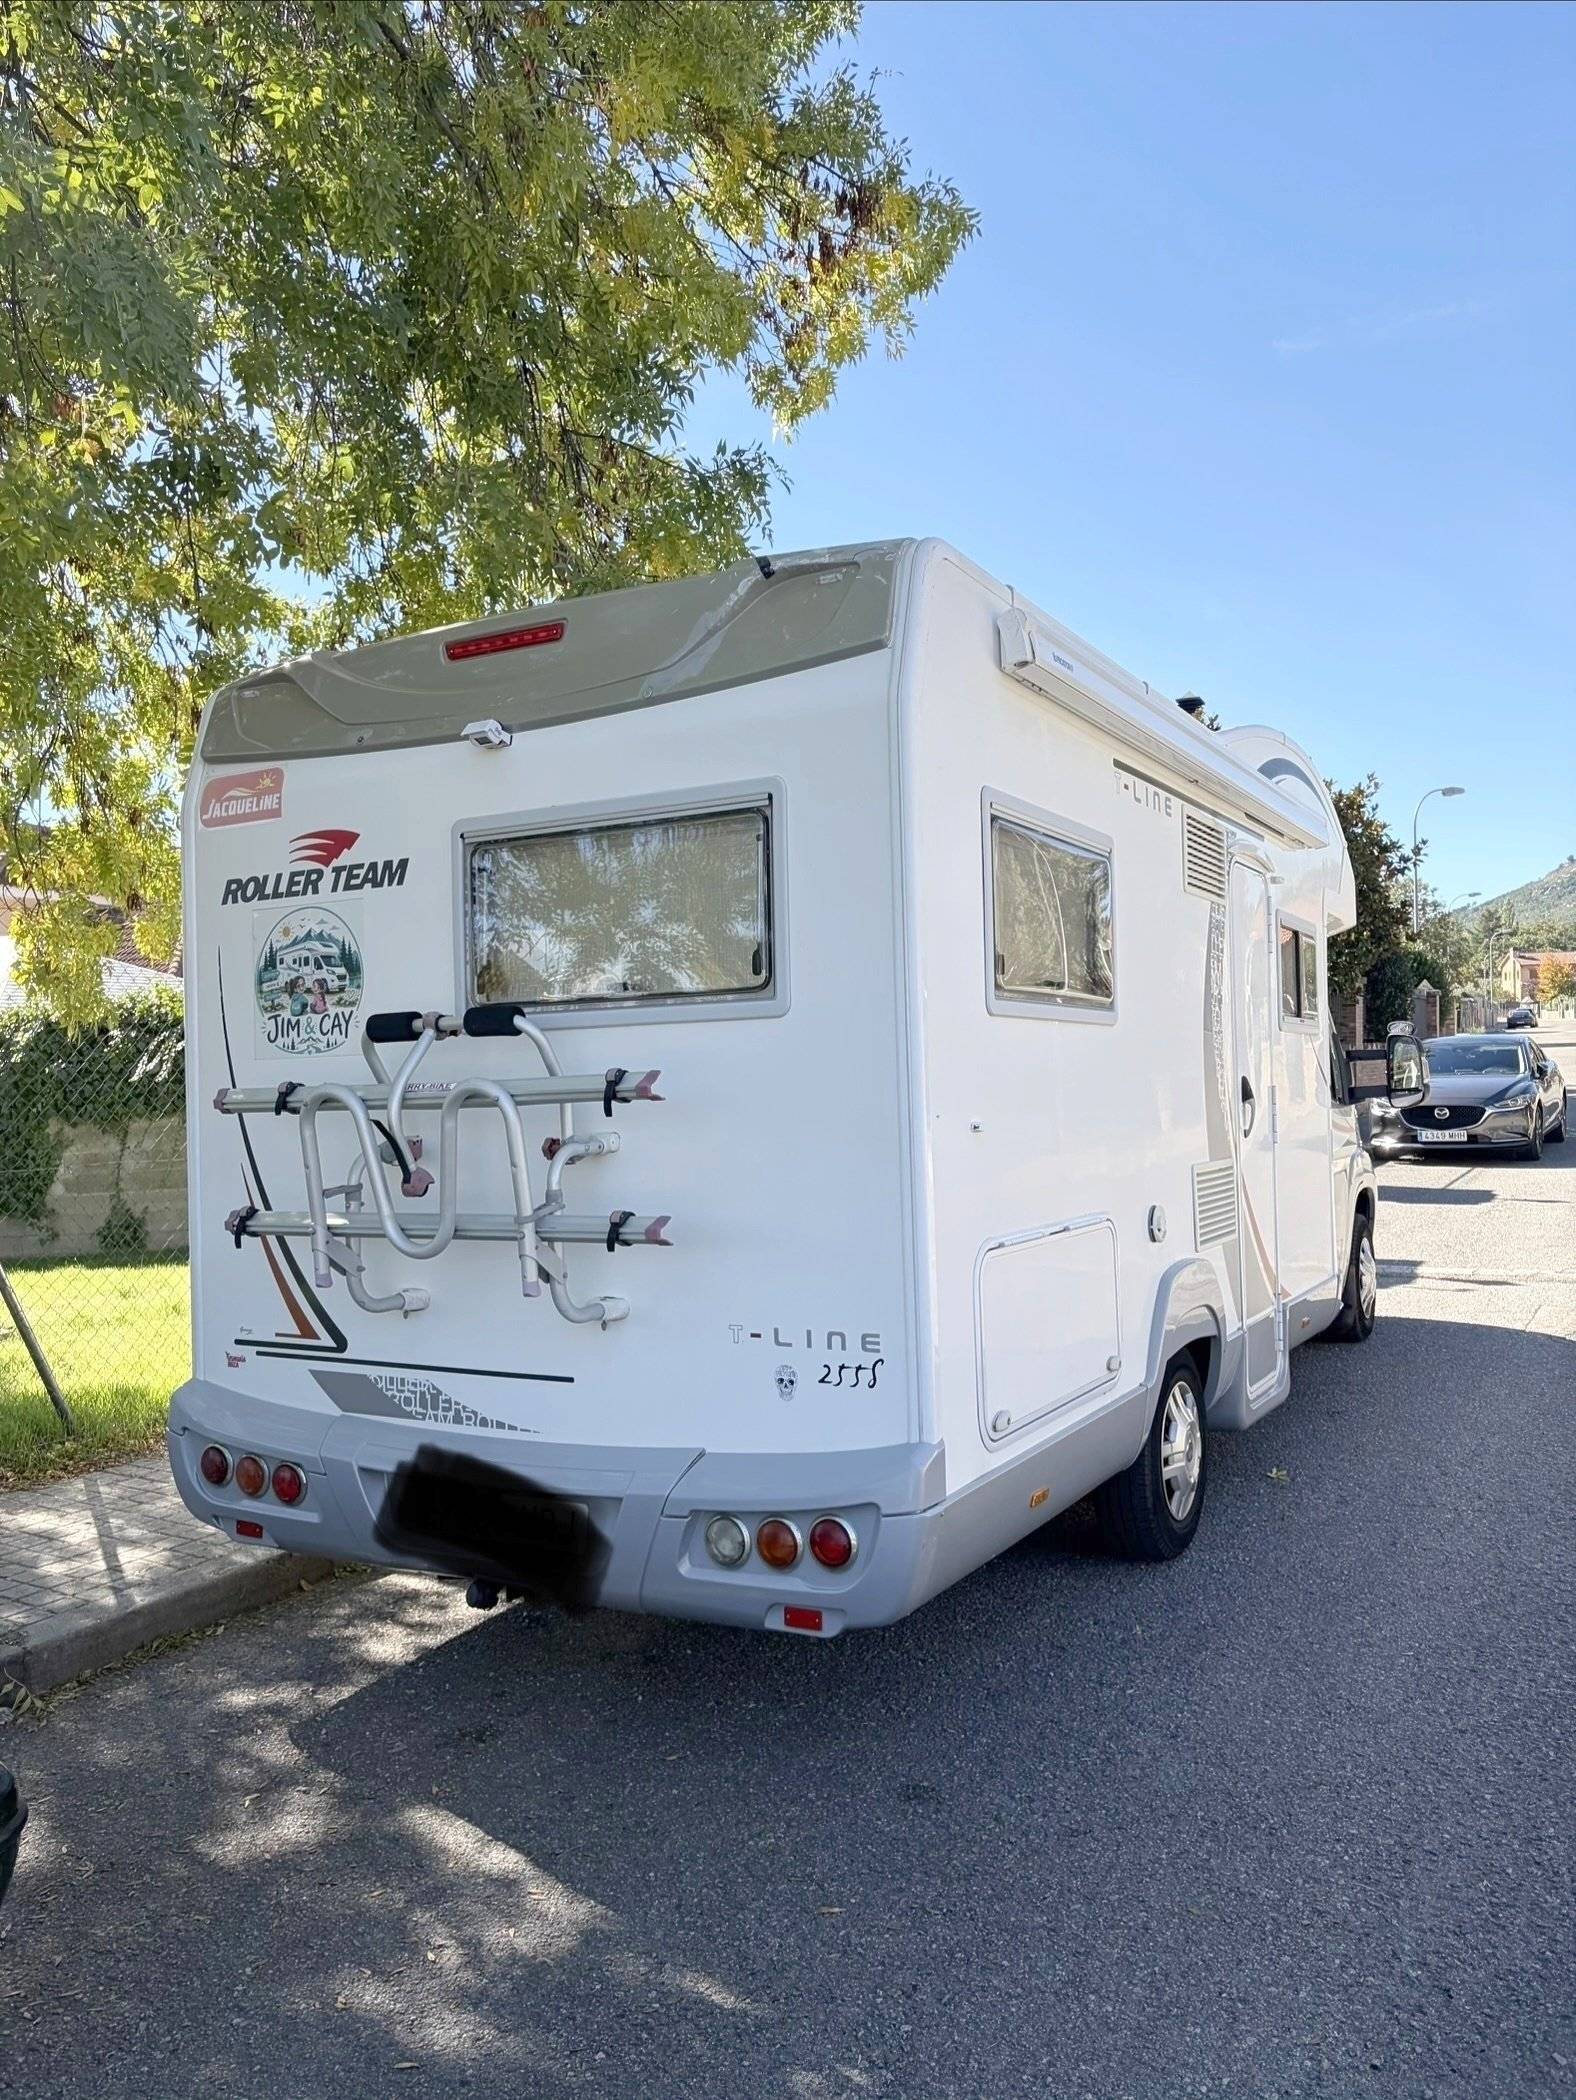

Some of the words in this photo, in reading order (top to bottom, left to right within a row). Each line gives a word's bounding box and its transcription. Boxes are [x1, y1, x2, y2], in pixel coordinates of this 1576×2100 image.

[221, 868, 325, 906] ROLLER
[330, 858, 410, 893] TEAM
[267, 1013, 301, 1044] JIM
[304, 1016, 317, 1035] &
[320, 1010, 354, 1039] CAY
[728, 1324, 881, 1354] T-LINE
